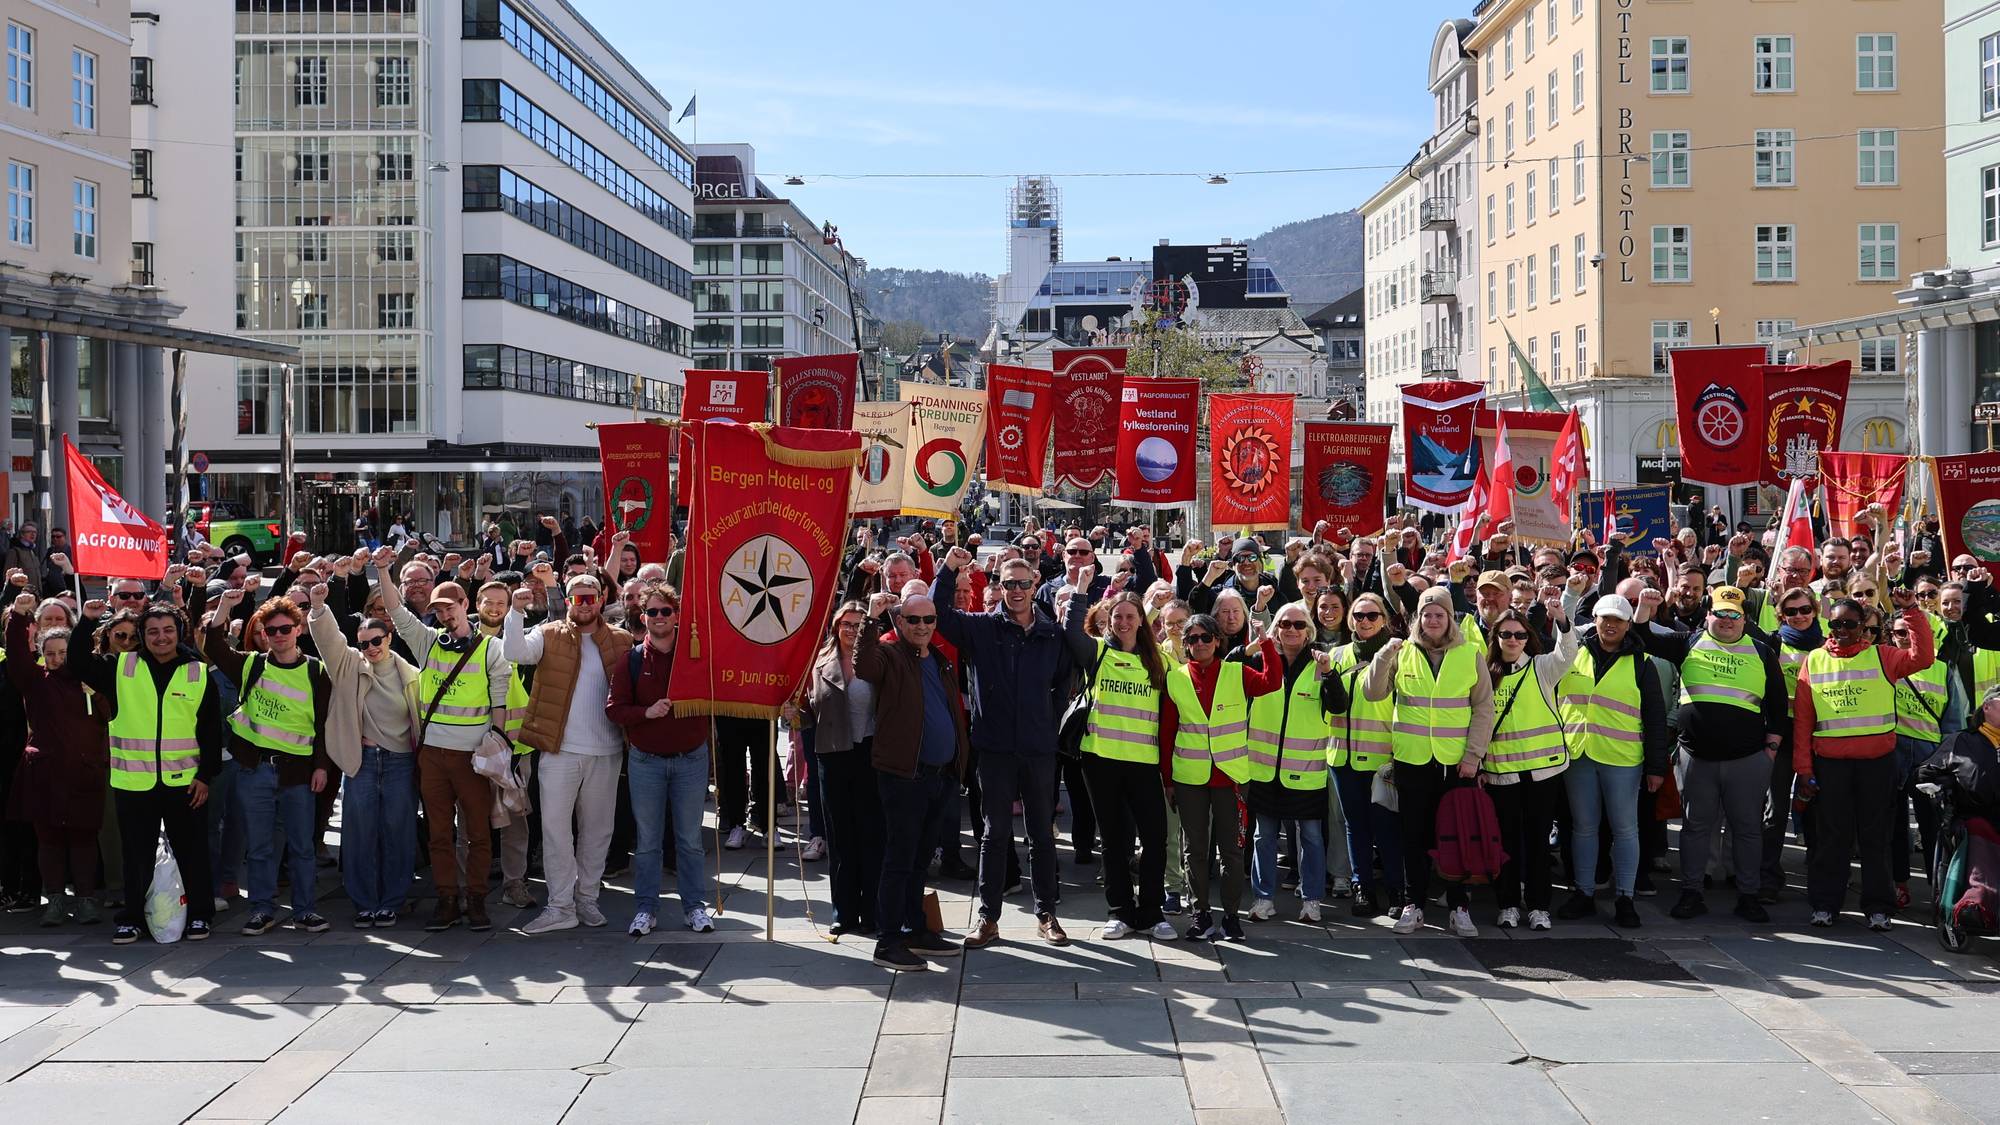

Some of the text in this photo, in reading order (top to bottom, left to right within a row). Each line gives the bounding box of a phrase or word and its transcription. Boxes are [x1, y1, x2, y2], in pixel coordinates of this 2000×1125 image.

[1618, 107, 1634, 283] BRISTOL
[784, 367, 847, 389] FELLESFORBUNDET
[1070, 372, 1108, 381] VESTLANDET
[1065, 385, 1113, 404] HANDEL OG KONTOR
[1139, 392, 1190, 400] FAGFORBUNDET
[1768, 388, 1789, 400] BERGEN
[1820, 388, 1843, 400] UNGDOM
[700, 405, 744, 413] FAGFORBUNDET
[912, 395, 983, 413] UTDANNINGS
[915, 406, 979, 424] FORBUNDET
[1135, 408, 1177, 418] Vestland
[1436, 414, 1452, 425] FO
[933, 423, 956, 432] Bergen
[1123, 420, 1189, 434] fylkesforening
[1430, 425, 1460, 433] Vestland
[1308, 432, 1387, 444] ELEKTROARBEIDERNES
[1323, 445, 1372, 456] FAGFORENING
[710, 465, 764, 489] Bergen
[1326, 514, 1360, 523] VESTLAND
[700, 497, 834, 557] Restaurantarbeiderforening
[77, 532, 161, 553] AGFORBUNDE
[1703, 652, 1748, 667] Streike-
[1713, 664, 1737, 675] vakt
[738, 670, 761, 687] Juni
[765, 672, 791, 687] 1930
[1100, 678, 1152, 697] STREIKEVAKT
[1821, 685, 1868, 698] Streike-
[254, 689, 291, 712] Streike-
[1832, 695, 1858, 707] vakt
[257, 705, 279, 720] vakt
